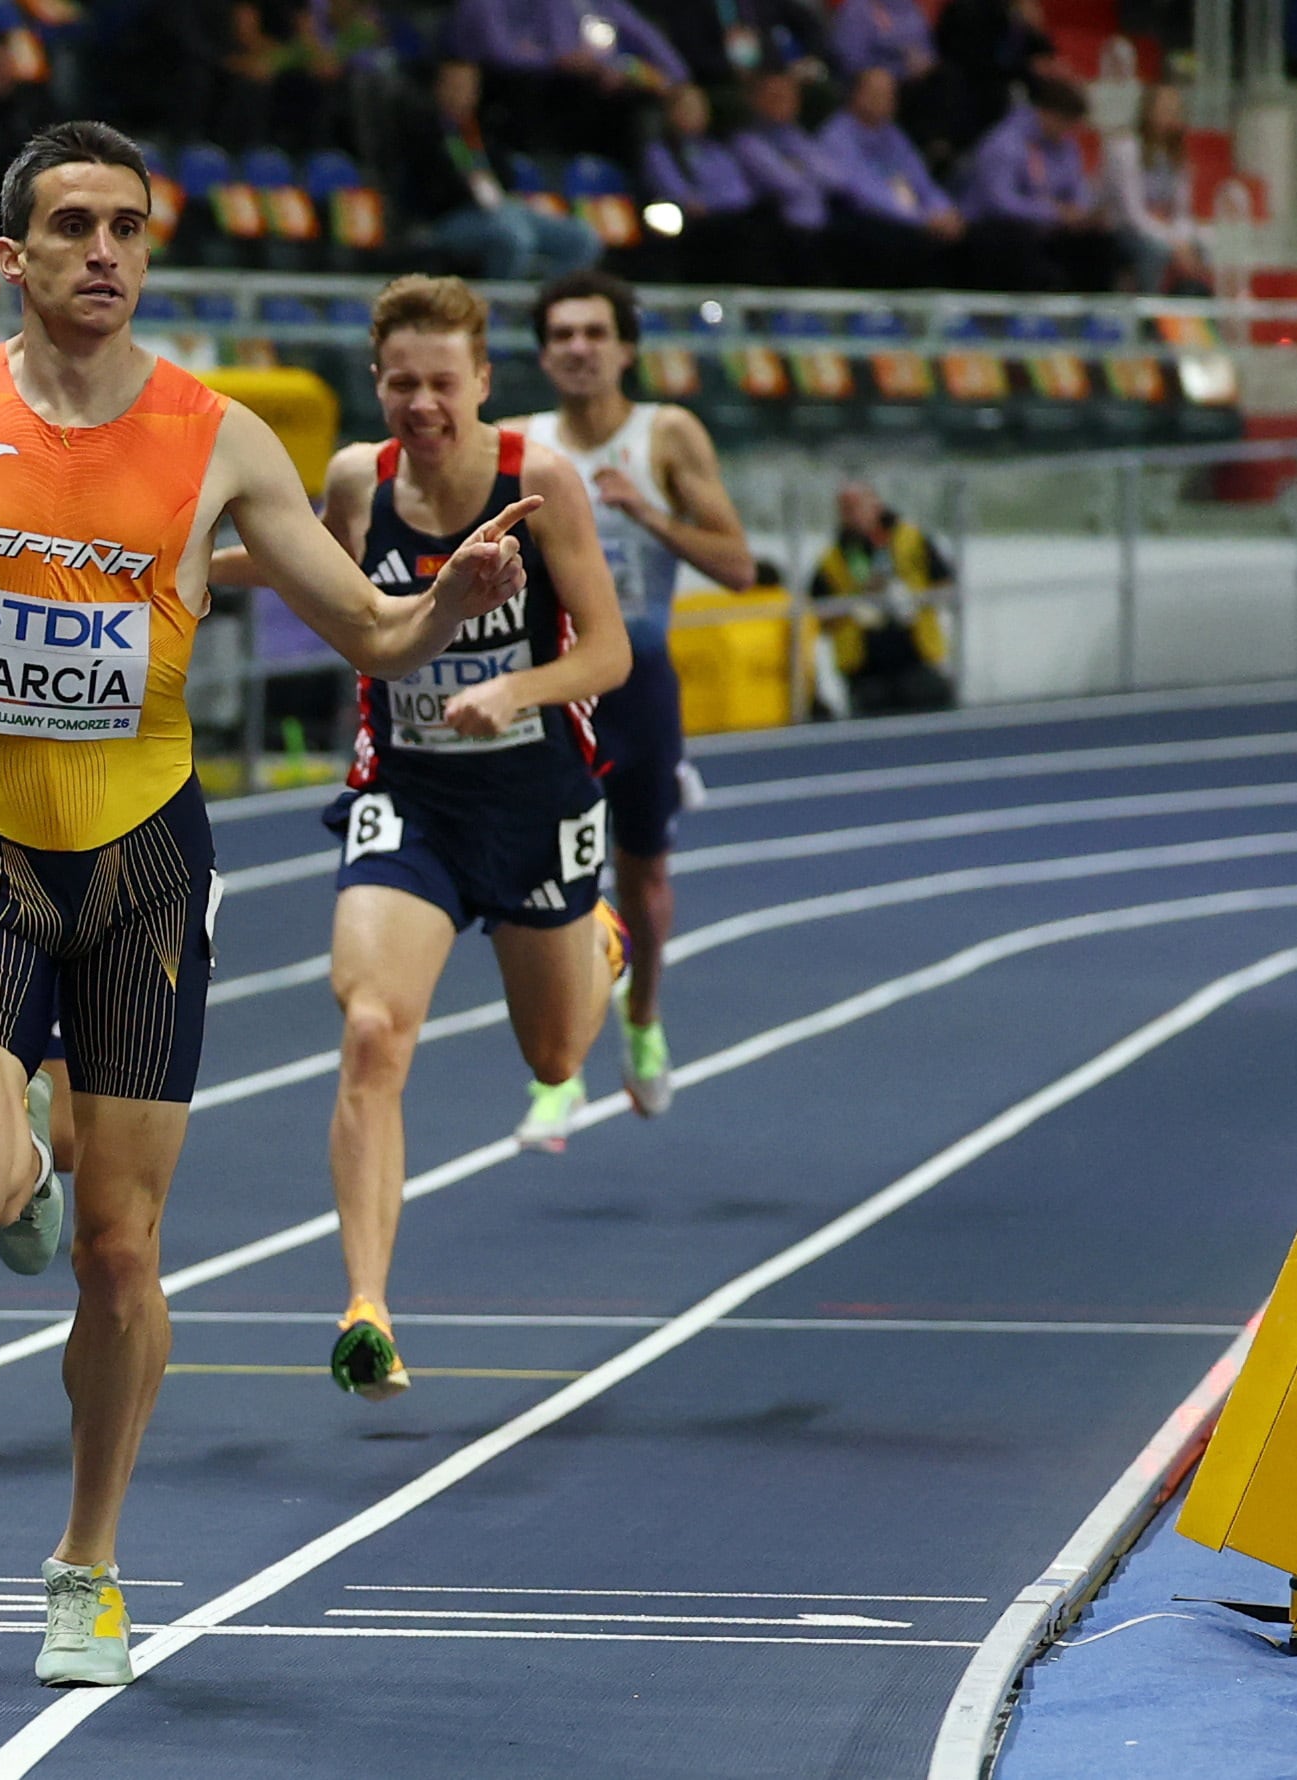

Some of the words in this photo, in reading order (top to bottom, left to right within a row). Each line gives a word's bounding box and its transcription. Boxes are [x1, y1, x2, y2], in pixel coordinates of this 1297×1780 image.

[2, 598, 134, 649] TDK
[47, 717, 111, 731] POMORZE
[113, 718, 130, 729] 26
[357, 805, 382, 845] 8
[575, 824, 596, 866] 8
